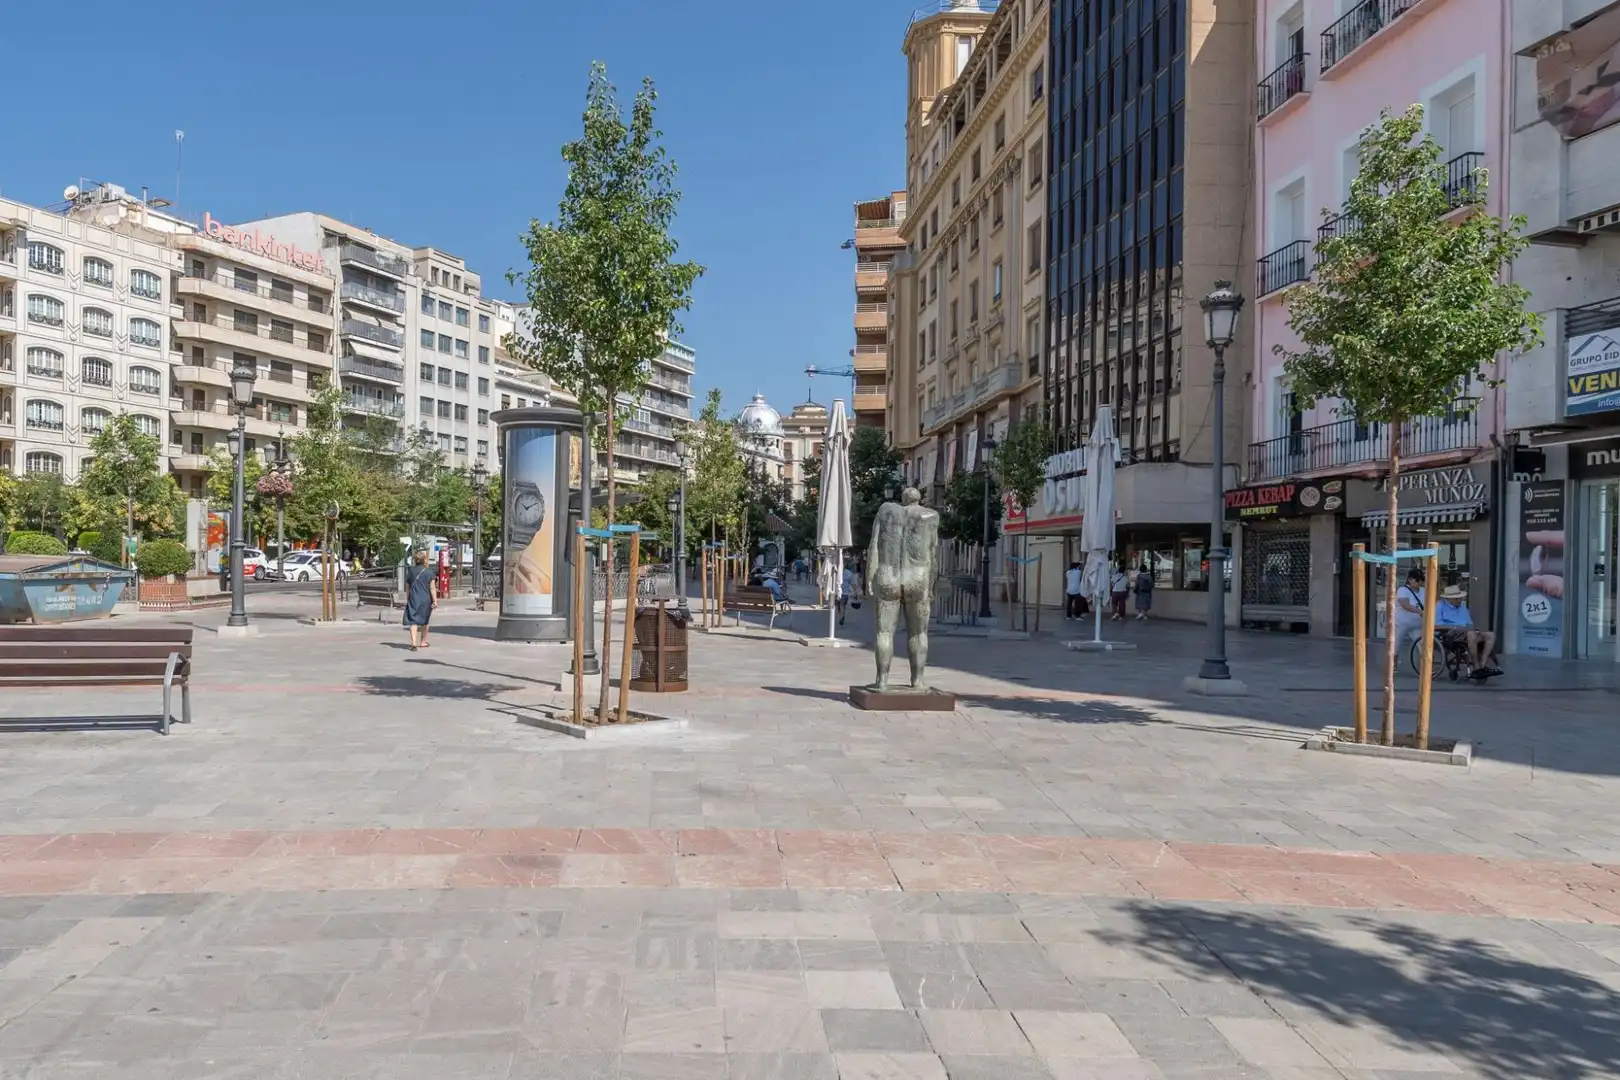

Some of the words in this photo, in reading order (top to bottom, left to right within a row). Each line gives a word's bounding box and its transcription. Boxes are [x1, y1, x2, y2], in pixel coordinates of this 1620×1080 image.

[203, 211, 325, 273] bankinter
[1570, 354, 1602, 367] GRUPO
[1569, 371, 1620, 394] VEN
[1383, 468, 1475, 493] EPERANZA
[1225, 490, 1255, 508] PIZZA
[1258, 484, 1295, 504] KEBAP
[1424, 483, 1484, 504] MUÑOZ
[1526, 600, 1548, 612] 2x1
